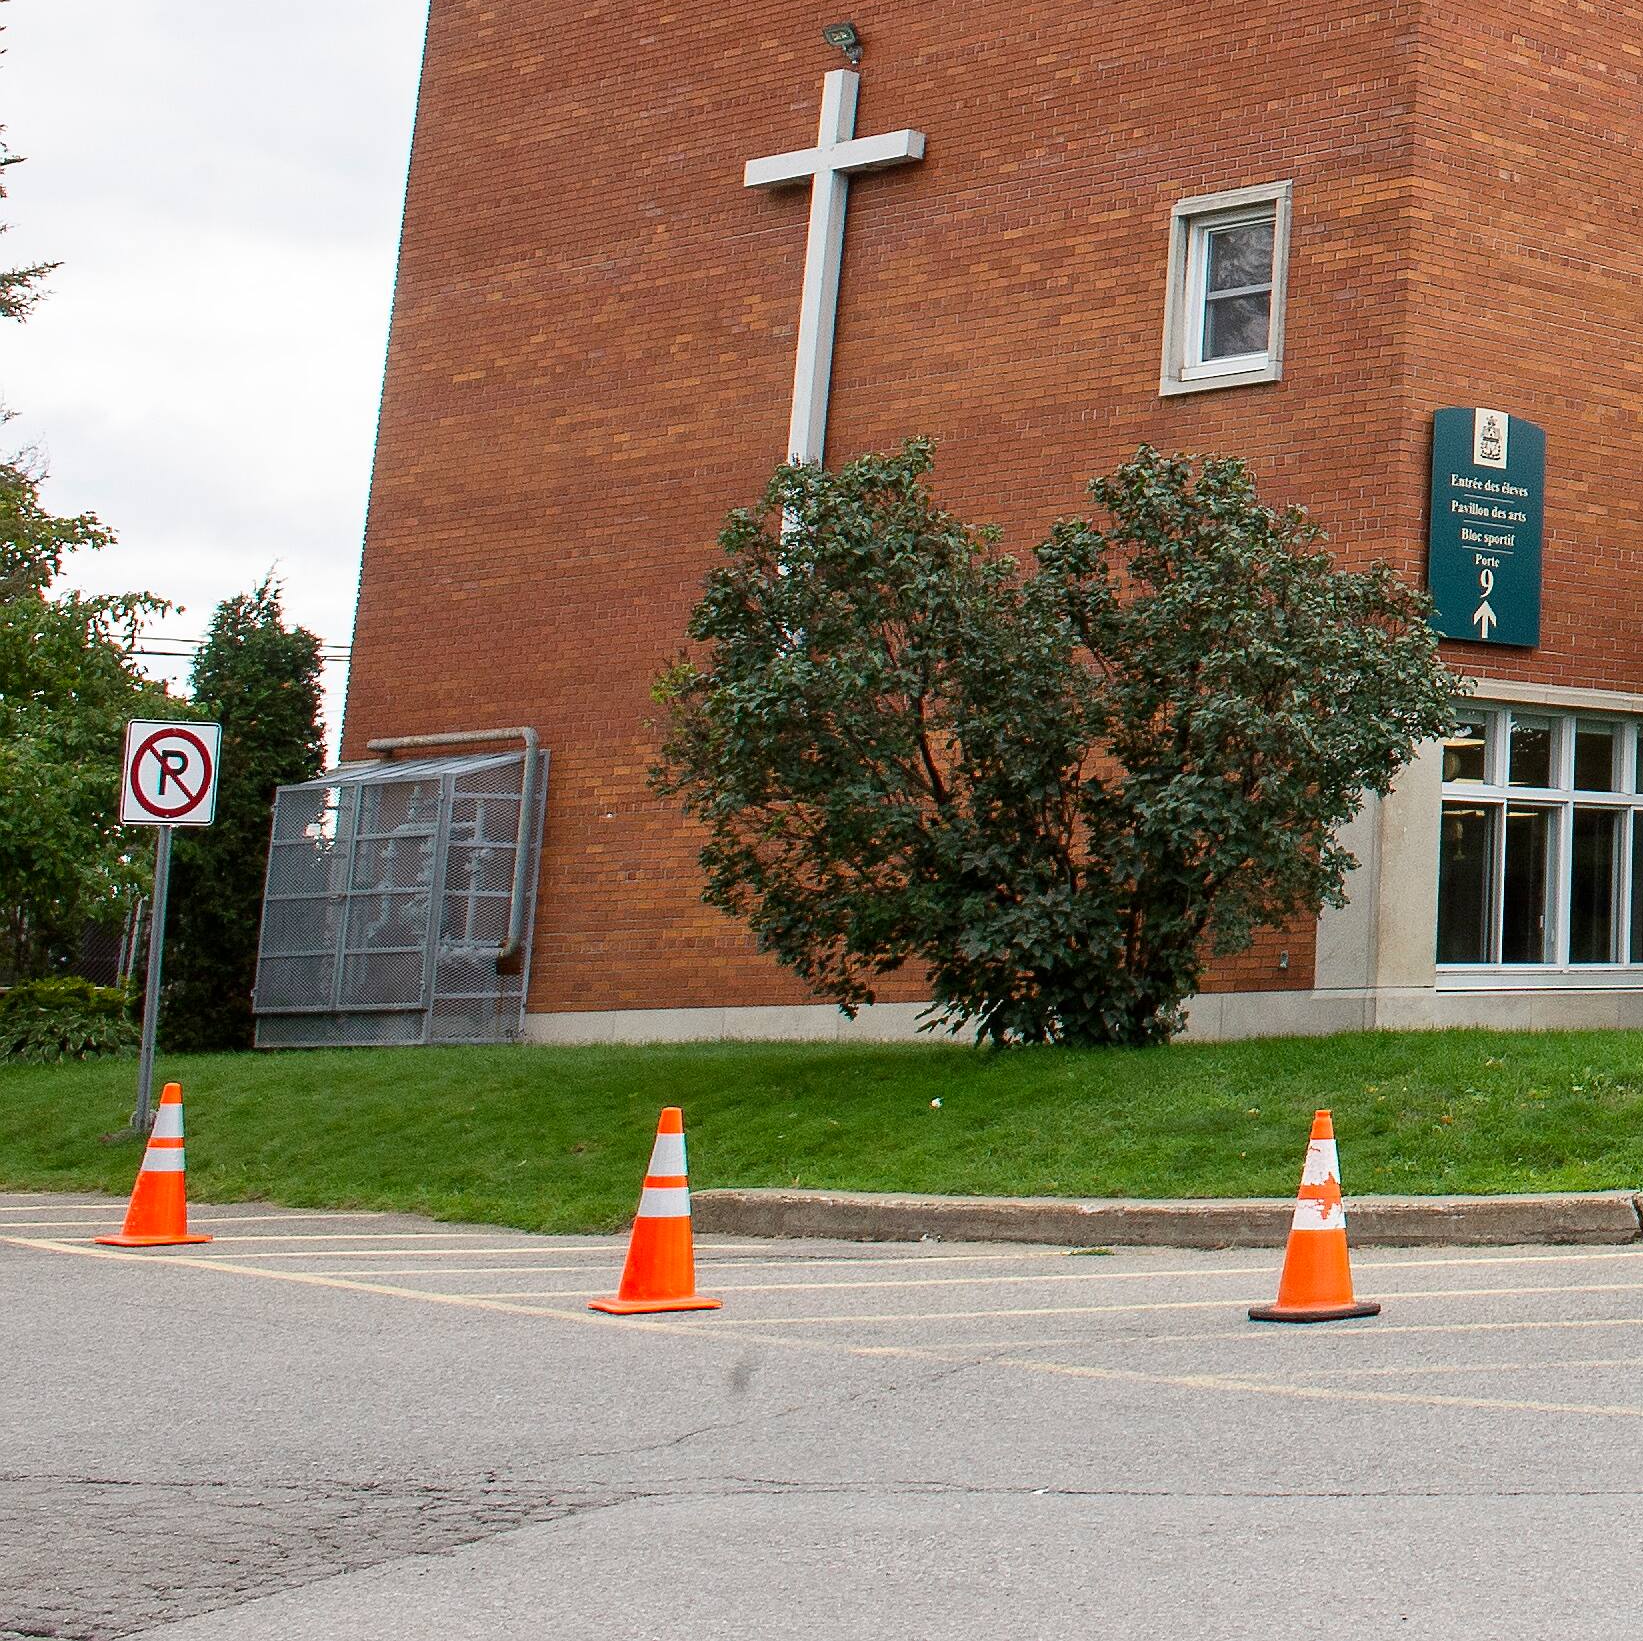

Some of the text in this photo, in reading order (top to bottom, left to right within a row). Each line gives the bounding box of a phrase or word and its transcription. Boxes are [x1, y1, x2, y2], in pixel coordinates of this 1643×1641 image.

[1451, 473, 1483, 490] Entrée
[1484, 479, 1500, 492] des
[1451, 499, 1527, 522] Pavillon des arts
[1461, 527, 1515, 547] Bloc sportif
[1475, 553, 1500, 568] Porte
[1479, 568, 1494, 599] 9
[158, 750, 189, 795] P
